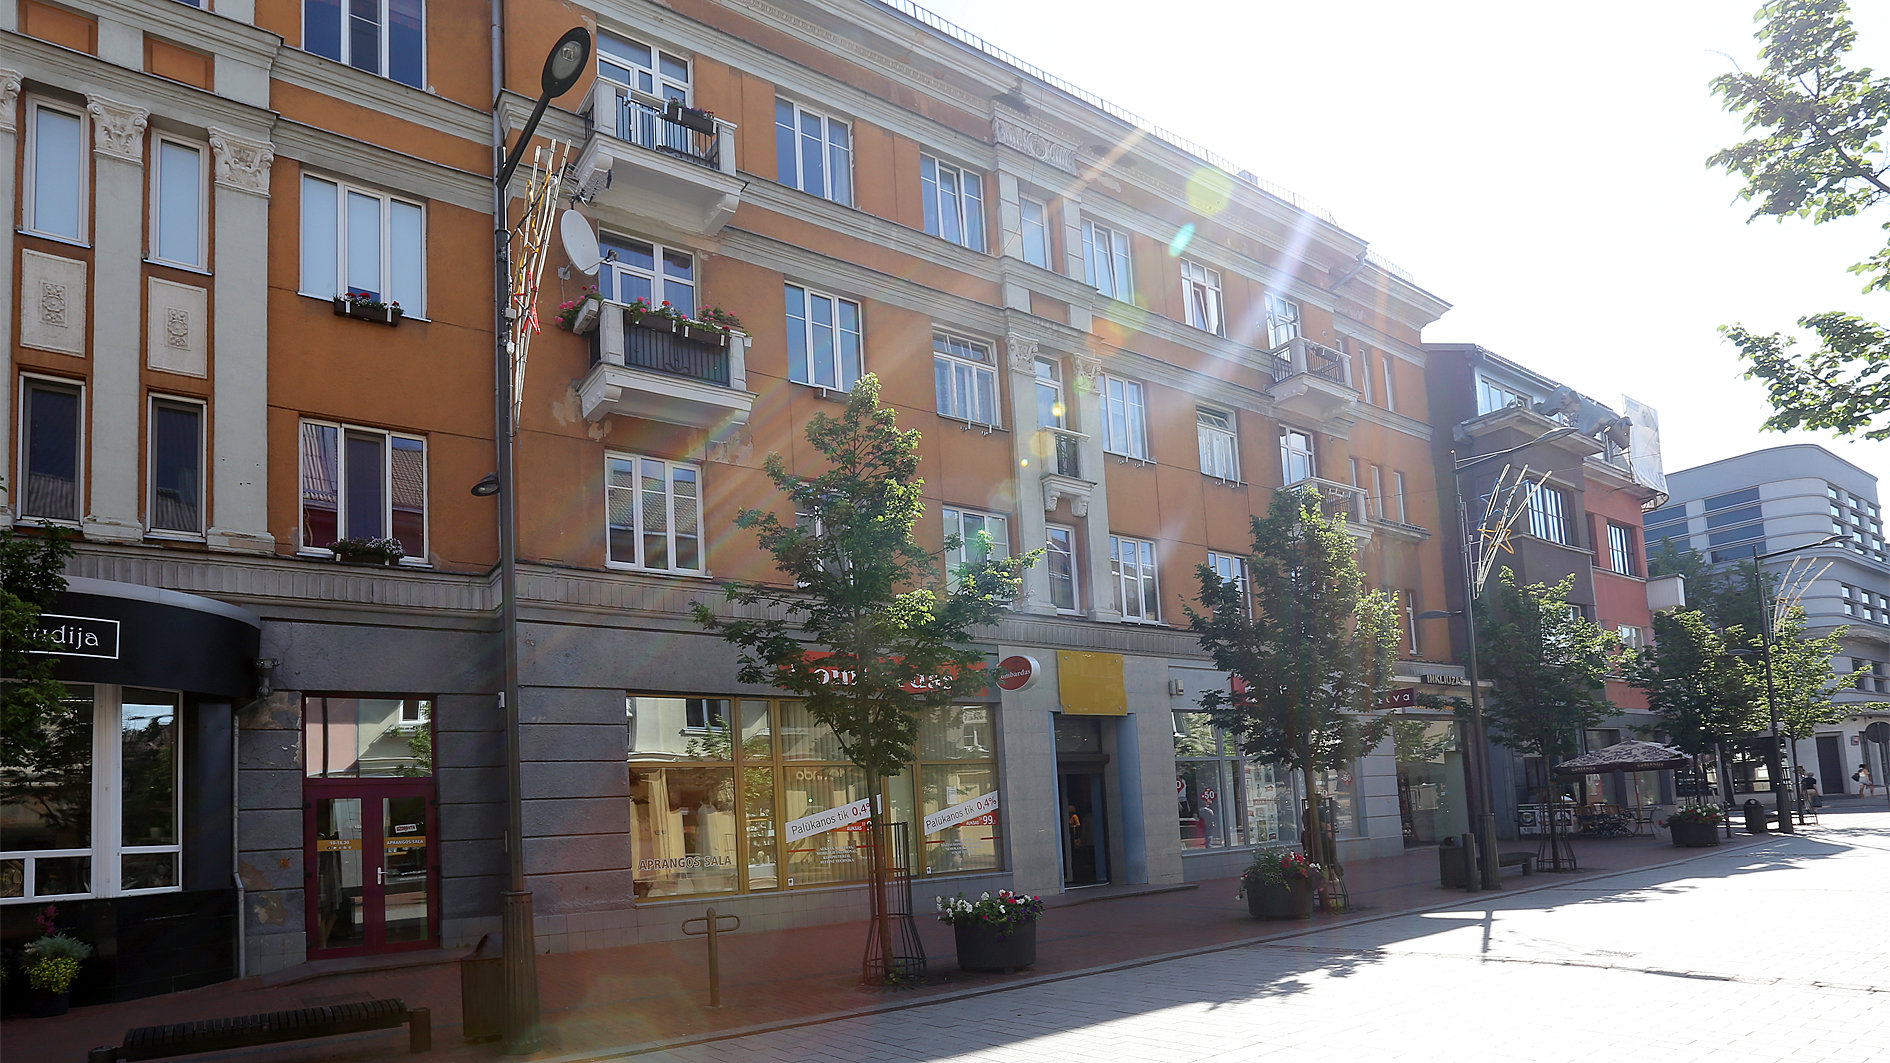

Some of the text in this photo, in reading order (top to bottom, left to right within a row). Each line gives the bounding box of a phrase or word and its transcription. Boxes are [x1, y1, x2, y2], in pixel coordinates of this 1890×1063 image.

[1000, 668, 1031, 679] ombardas
[791, 815, 836, 836] Palūkanos
[837, 810, 850, 821] tik
[925, 810, 964, 830] Palūkanos
[964, 804, 975, 815] tik
[639, 855, 732, 870] APRANGOS SALA
